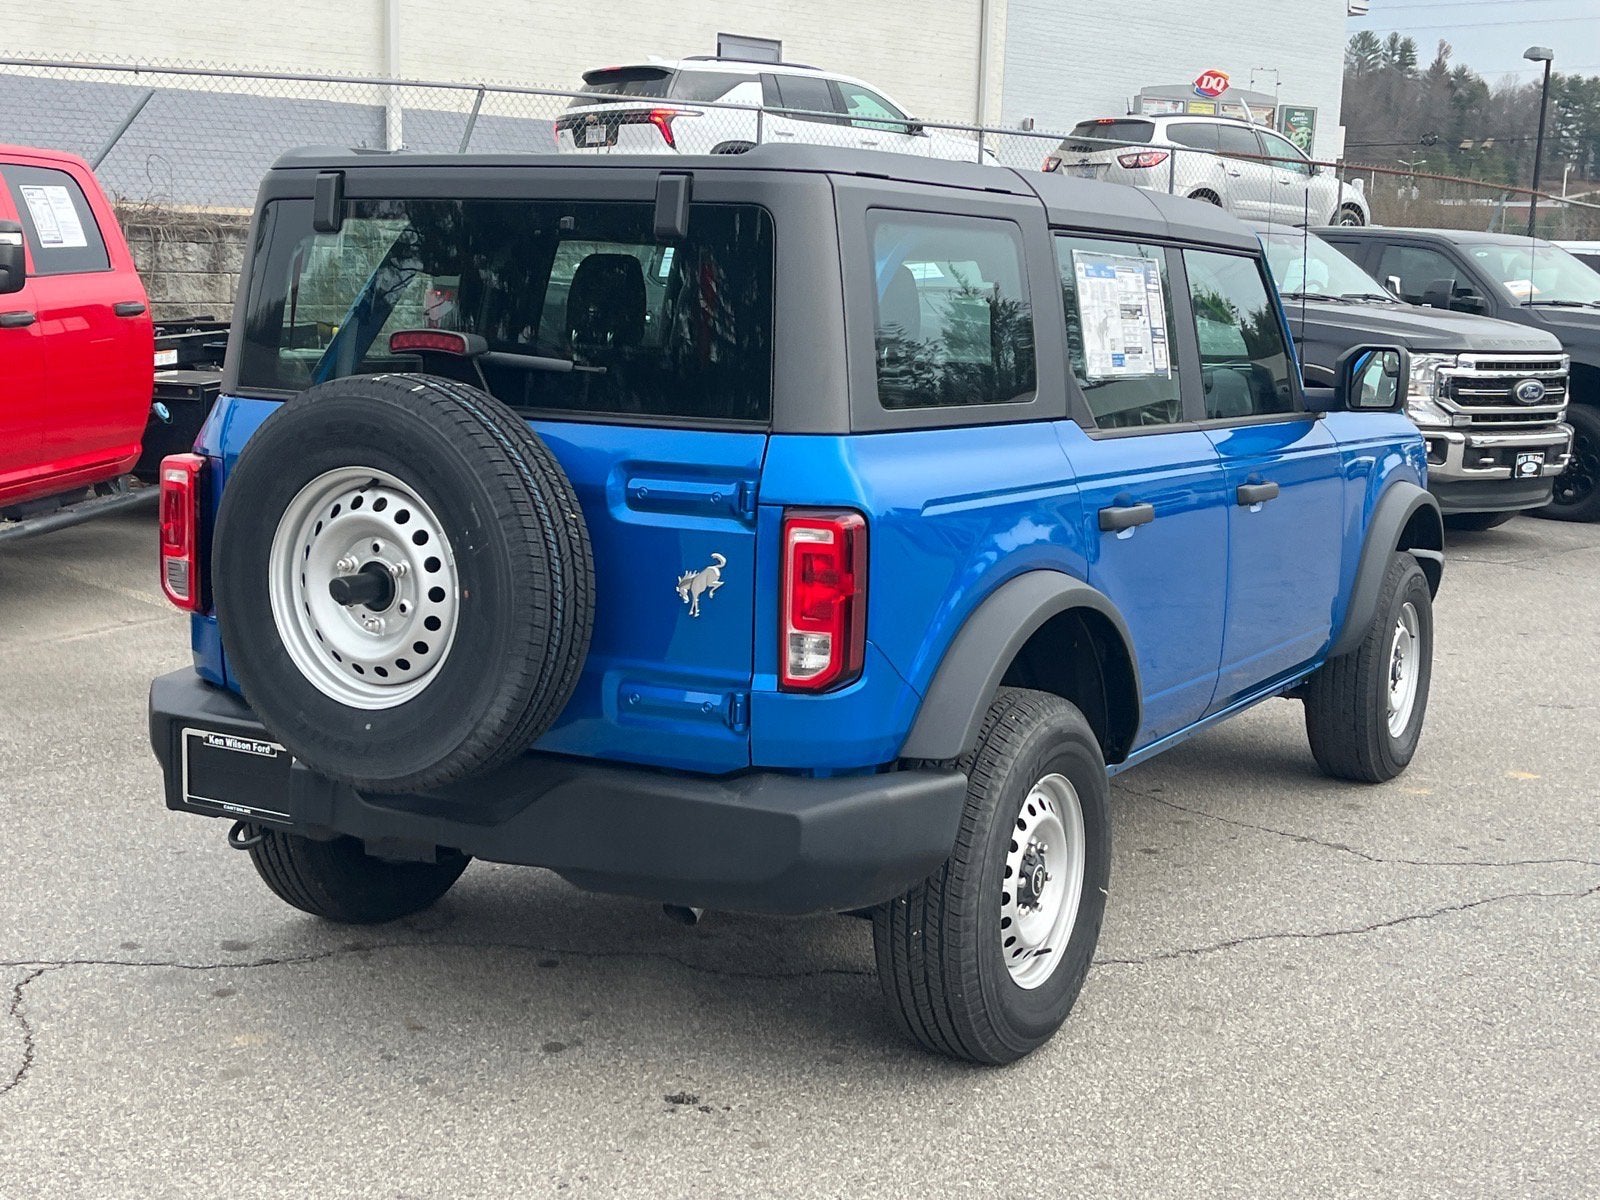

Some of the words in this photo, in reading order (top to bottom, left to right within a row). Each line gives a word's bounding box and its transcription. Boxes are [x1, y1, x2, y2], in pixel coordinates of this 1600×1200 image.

[1200, 75, 1225, 92] DQ
[209, 735, 223, 745] Ken
[226, 738, 251, 750] Wilson
[252, 743, 270, 753] Ford
